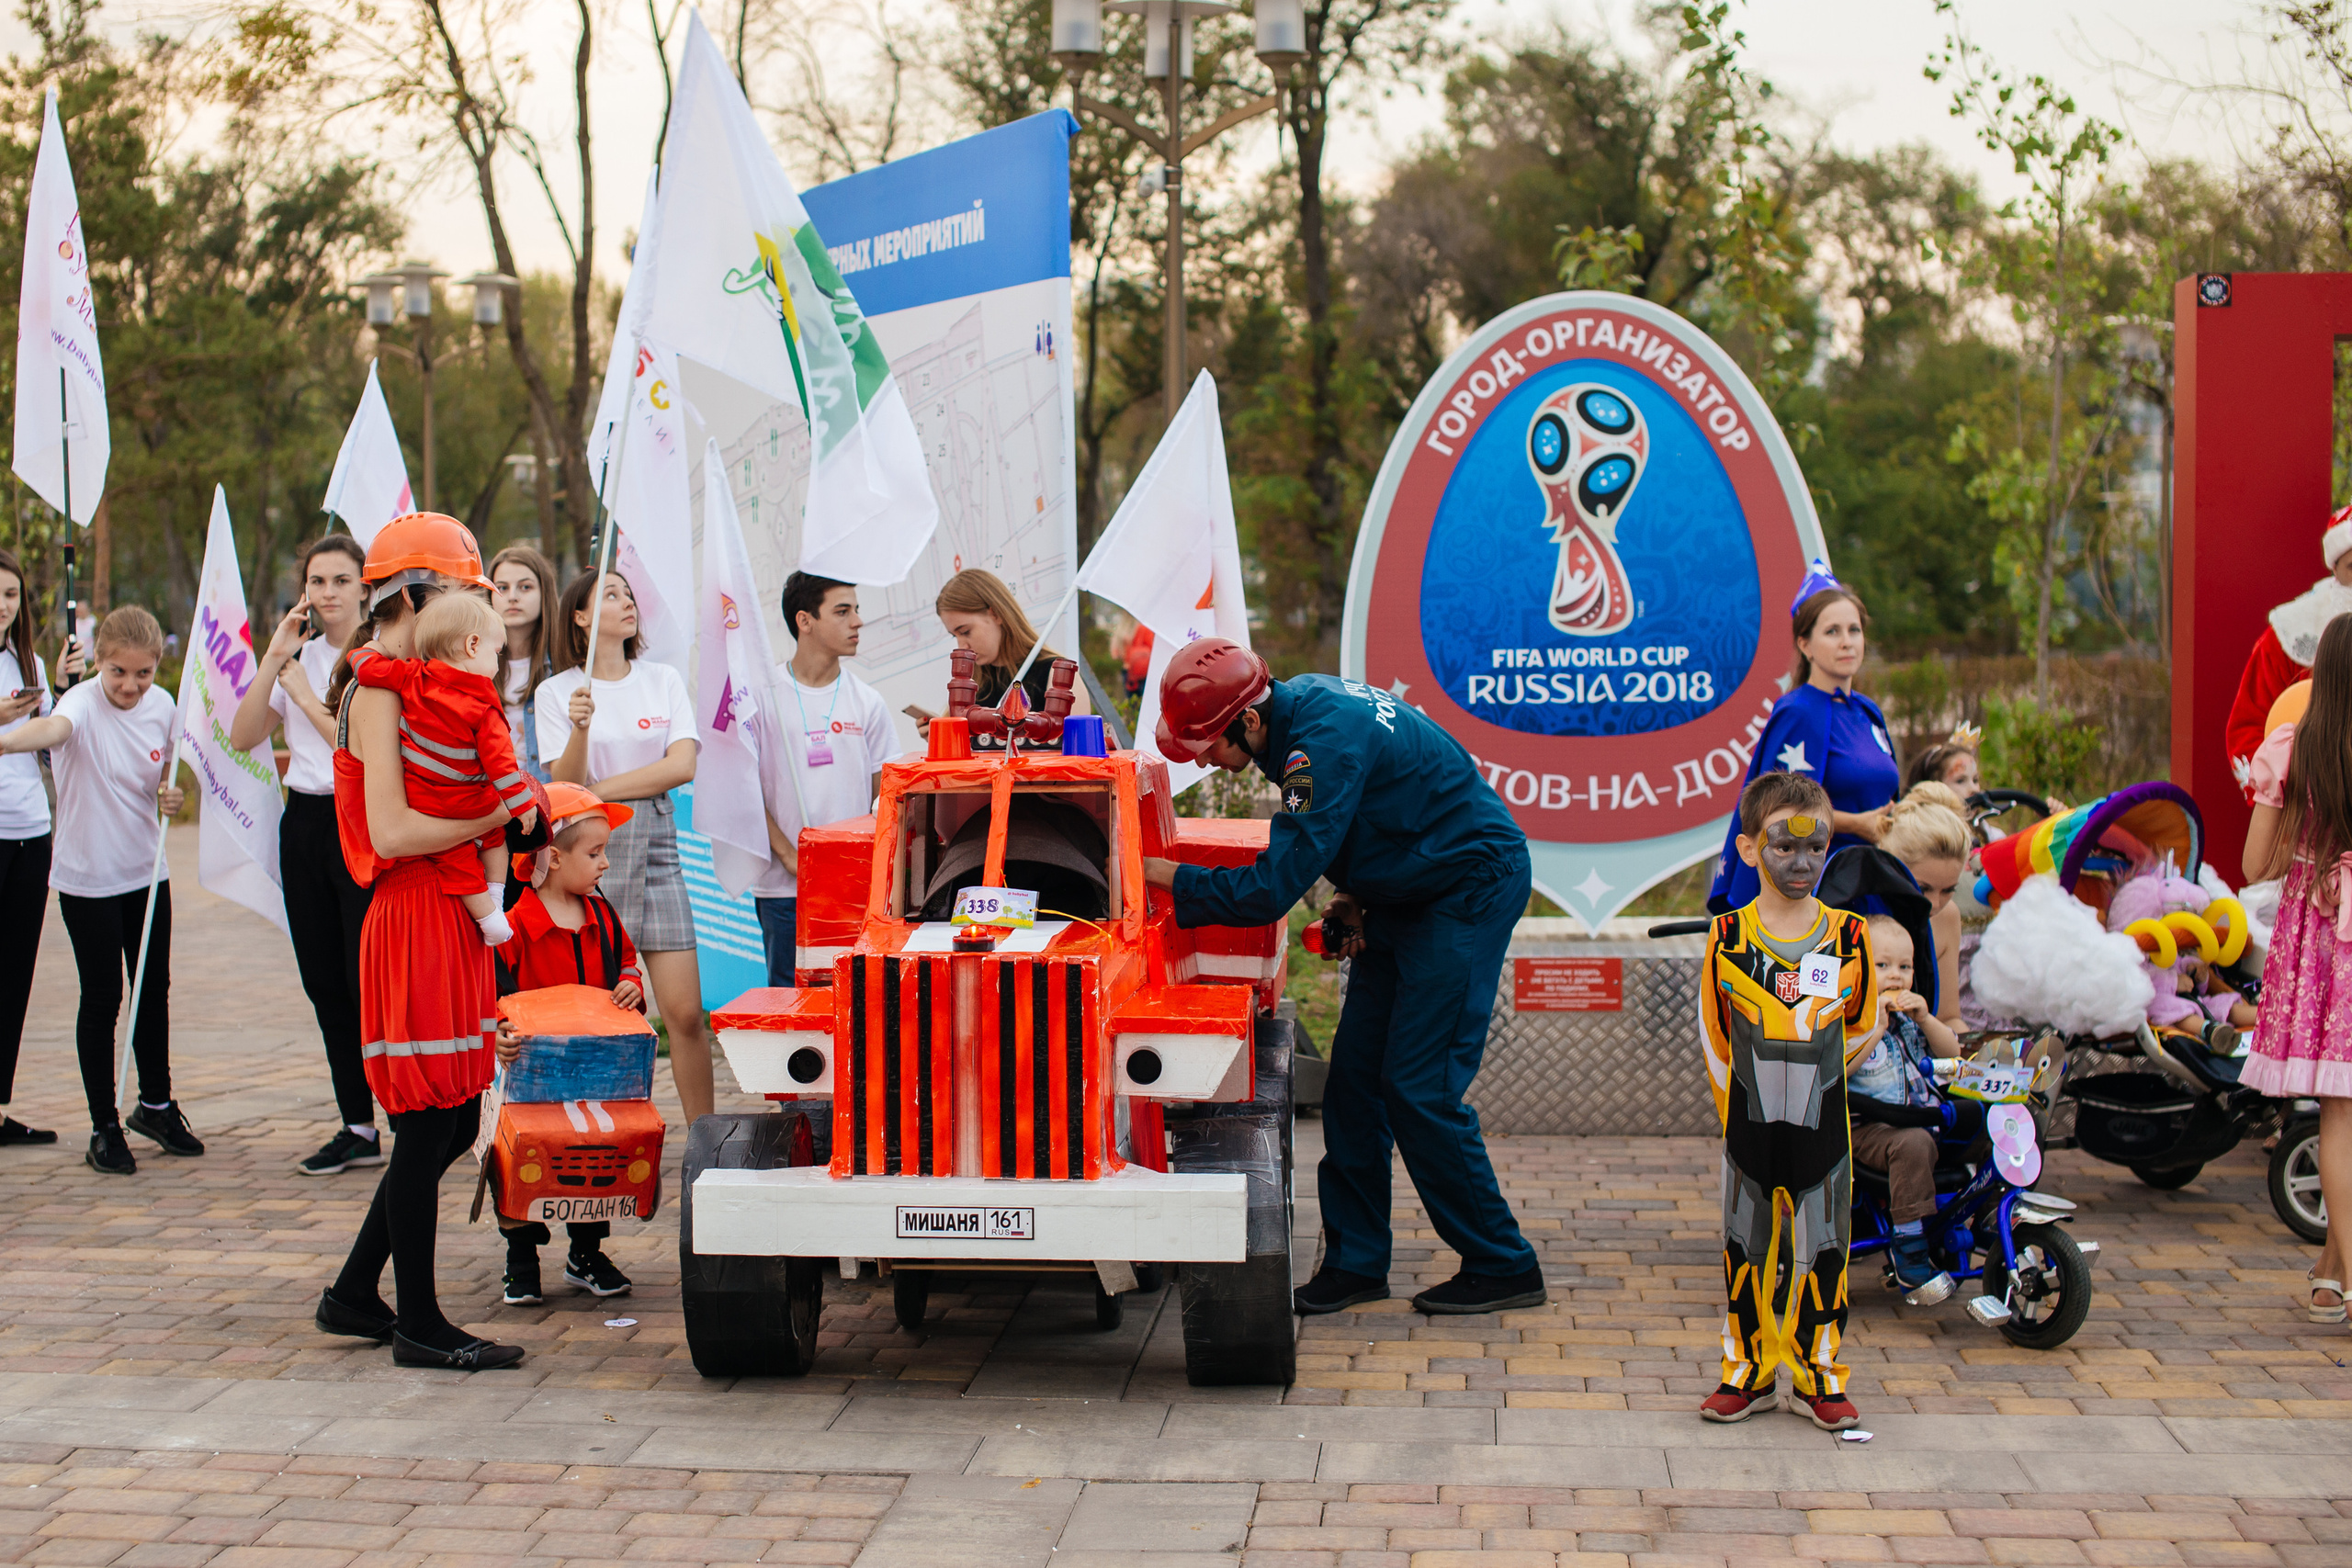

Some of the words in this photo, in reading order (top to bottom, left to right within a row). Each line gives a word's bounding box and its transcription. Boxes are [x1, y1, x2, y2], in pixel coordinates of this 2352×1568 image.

[873, 198, 985, 267] МЕРОПРИЯТИЙ
[1426, 318, 1751, 457] ГОРОД-ОРГАНИЗАТОР
[995, 555, 1003, 569] 27
[1492, 649, 1544, 668] FIFA
[1547, 647, 1638, 667] WORLD
[1641, 646, 1690, 666] CUP
[1468, 673, 1618, 705] RUSSIA
[1622, 671, 1714, 703] 2018
[183, 728, 254, 829] www.babybal.ru
[967, 898, 1000, 914] 338
[1811, 968, 1828, 984] 62
[1981, 1079, 2011, 1095] 337
[542, 1198, 616, 1221] БОГДАН
[618, 1196, 638, 1218] 161
[905, 1213, 979, 1232] МИШАНЯ
[989, 1210, 1021, 1229] 161
